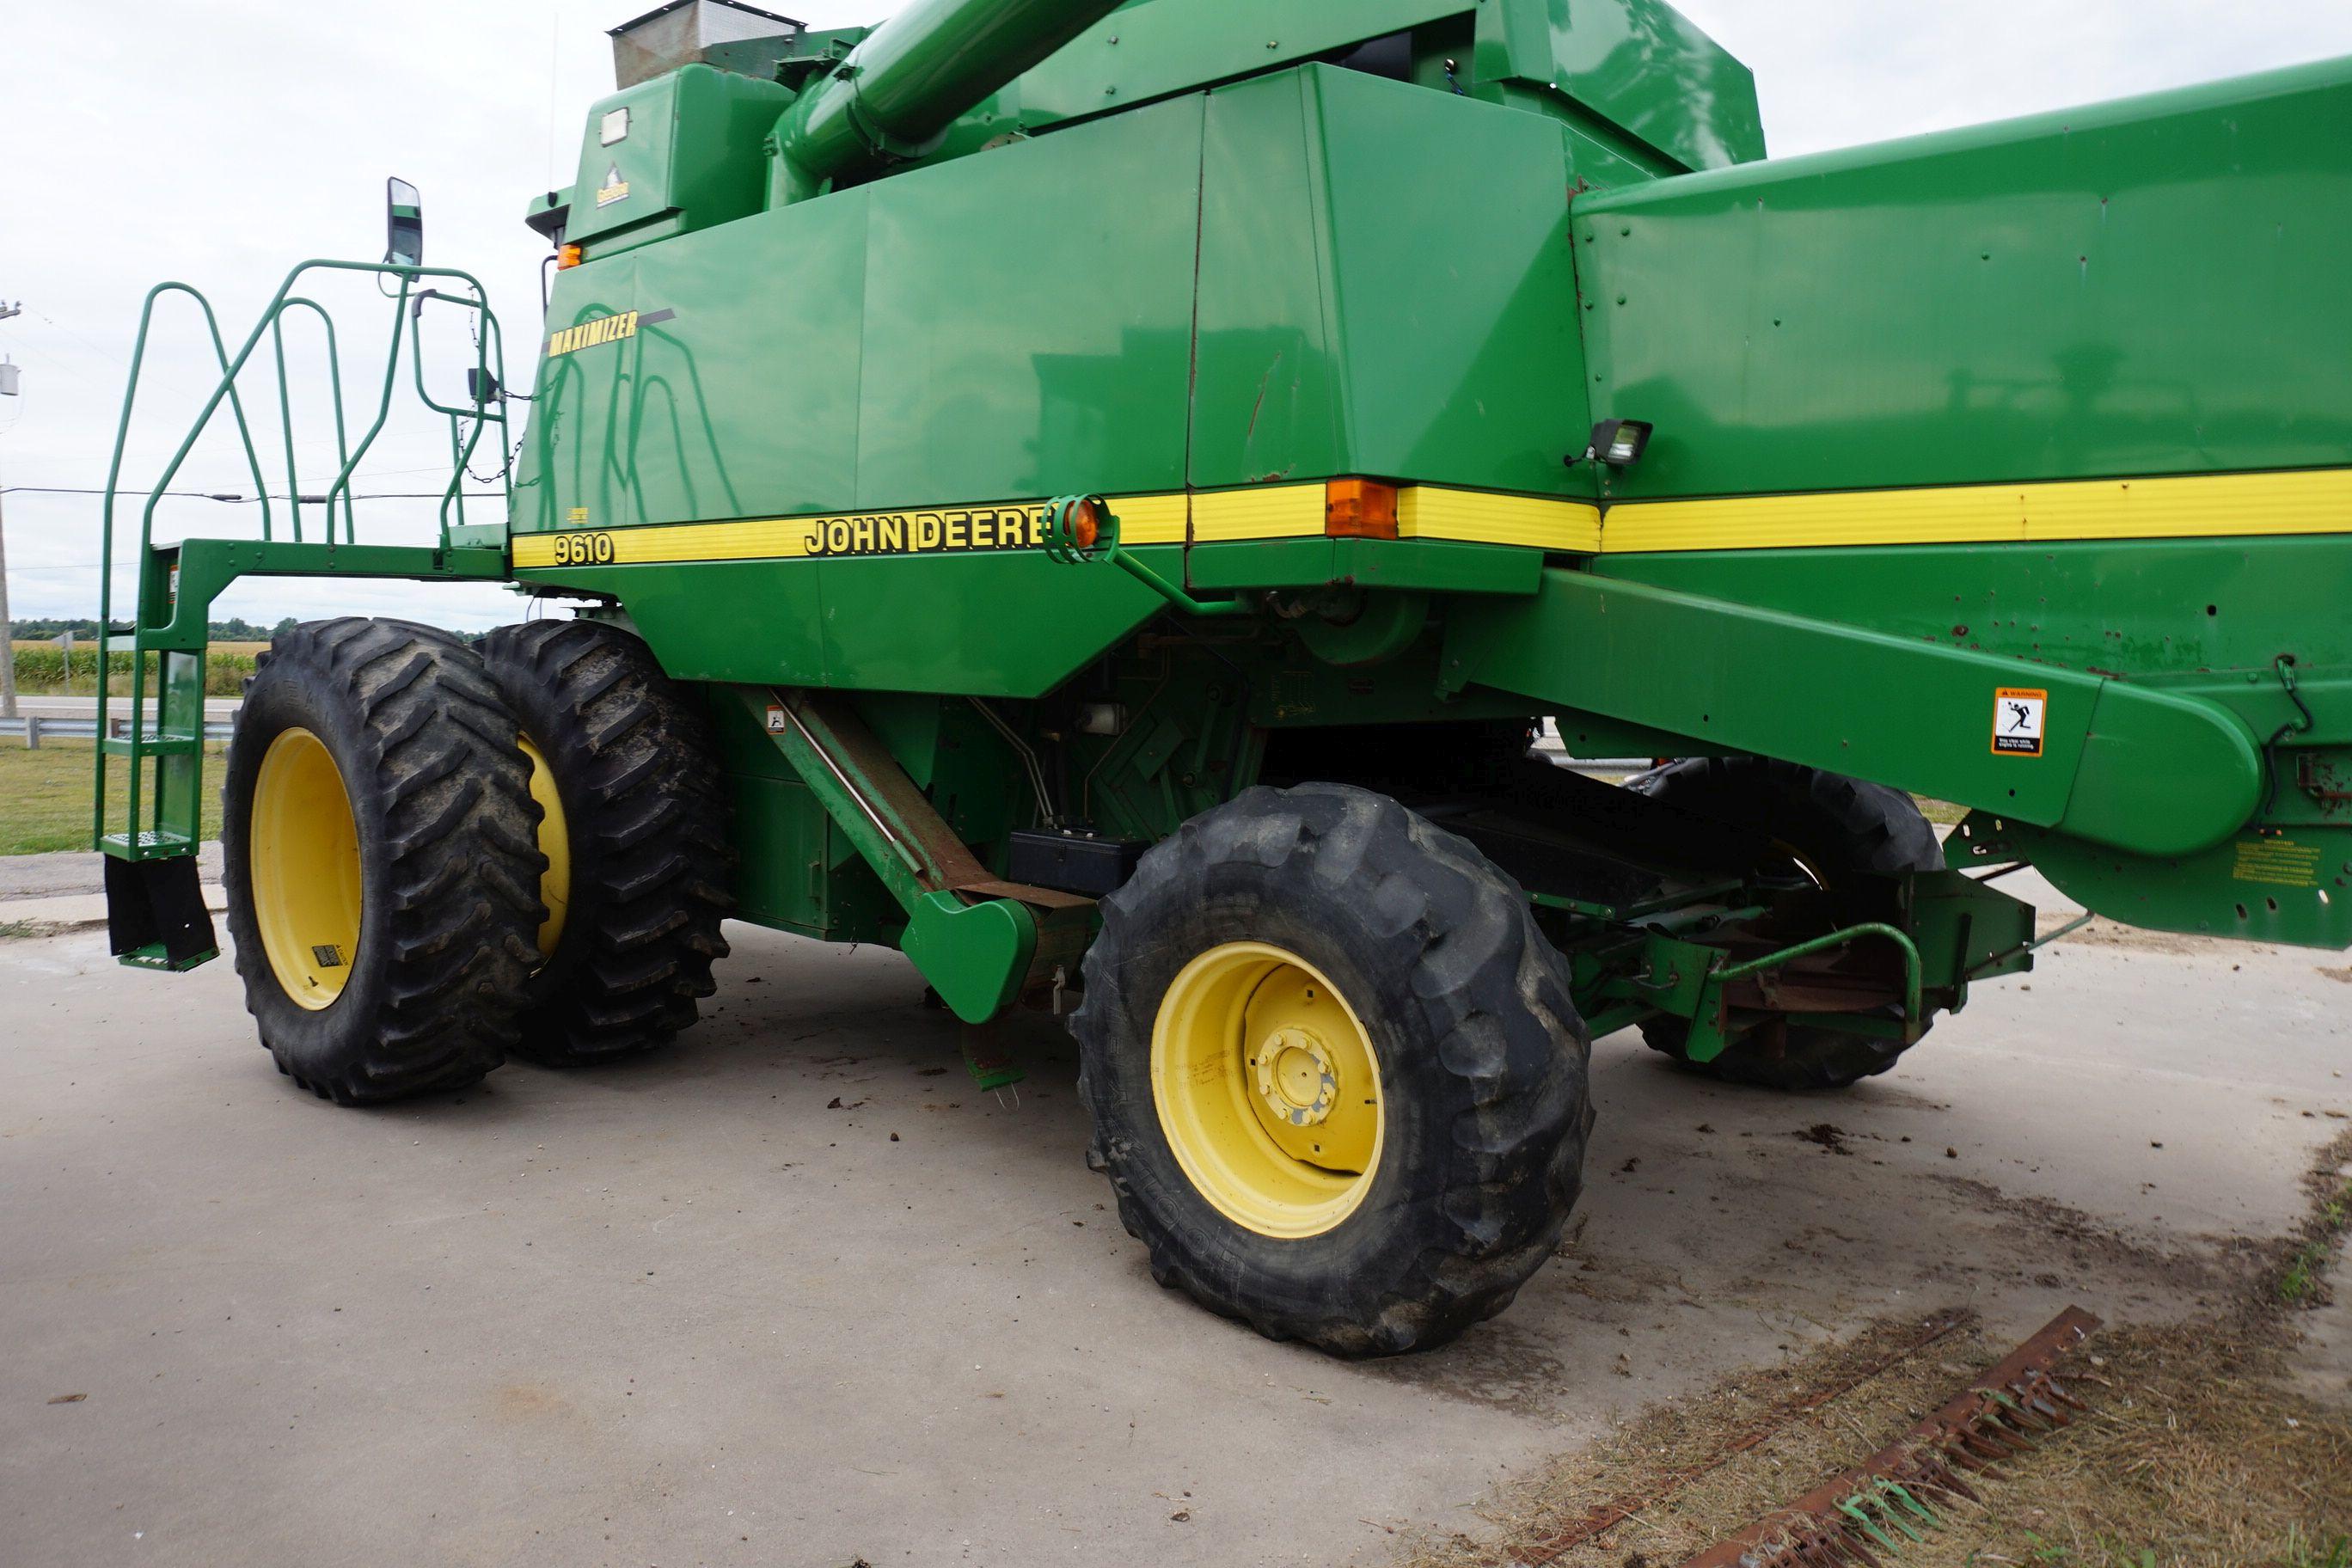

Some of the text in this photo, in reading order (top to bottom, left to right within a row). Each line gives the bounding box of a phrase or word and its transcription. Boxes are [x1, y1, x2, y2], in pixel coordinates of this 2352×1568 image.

[548, 310, 639, 358] MAXIMIZER
[554, 533, 614, 565] 9610
[804, 507, 1056, 556] JOHN DEERE
